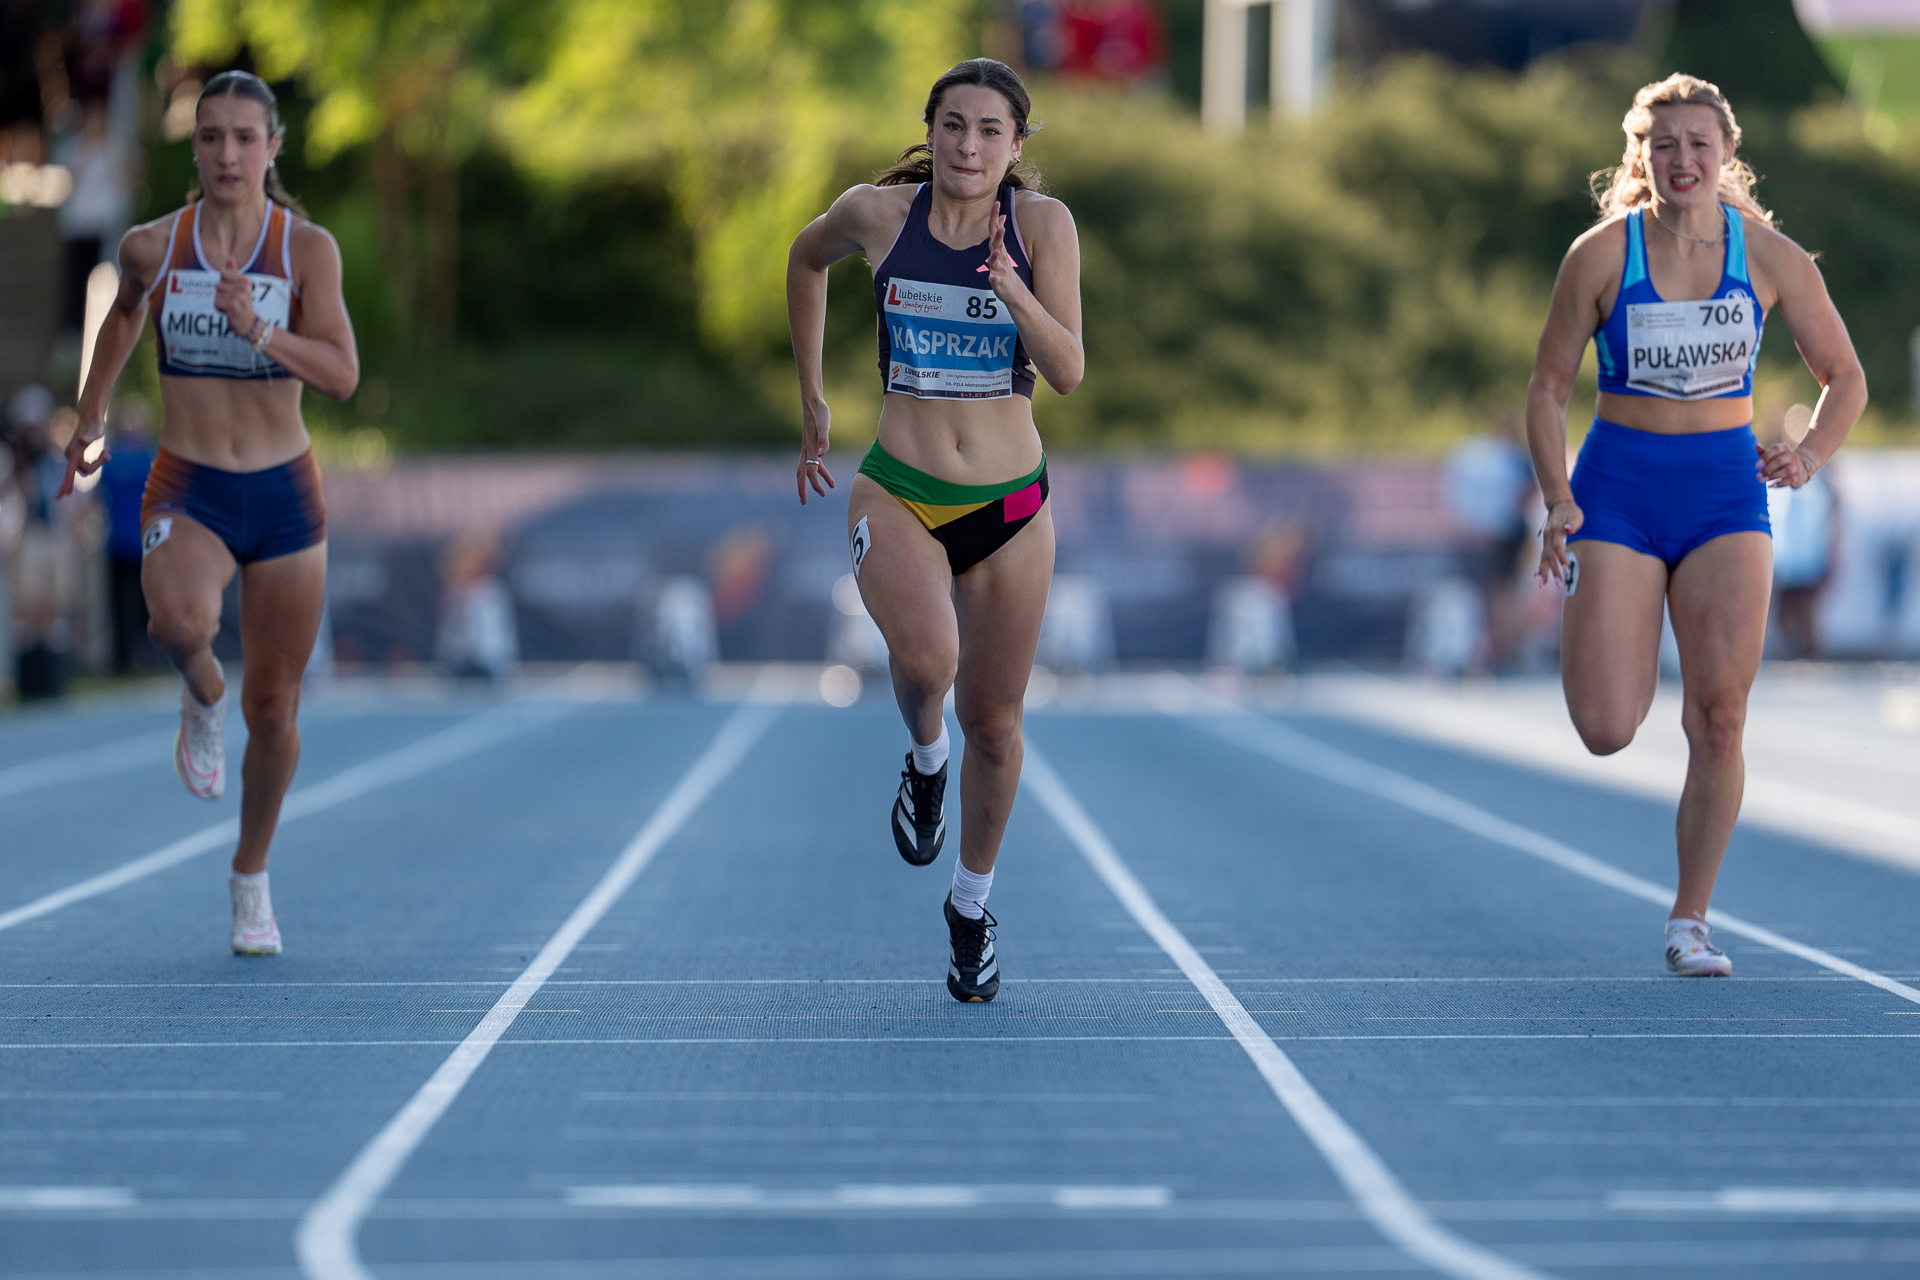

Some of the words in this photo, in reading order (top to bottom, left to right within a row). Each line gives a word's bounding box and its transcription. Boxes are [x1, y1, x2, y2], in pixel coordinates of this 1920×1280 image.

[898, 288, 943, 304] lubelskie
[966, 295, 998, 319] 85
[1699, 303, 1744, 326] 706
[892, 325, 1011, 359] KASPRZAK
[1634, 340, 1747, 369] PUŁAWSKA
[904, 367, 941, 379] LUBELSKIE
